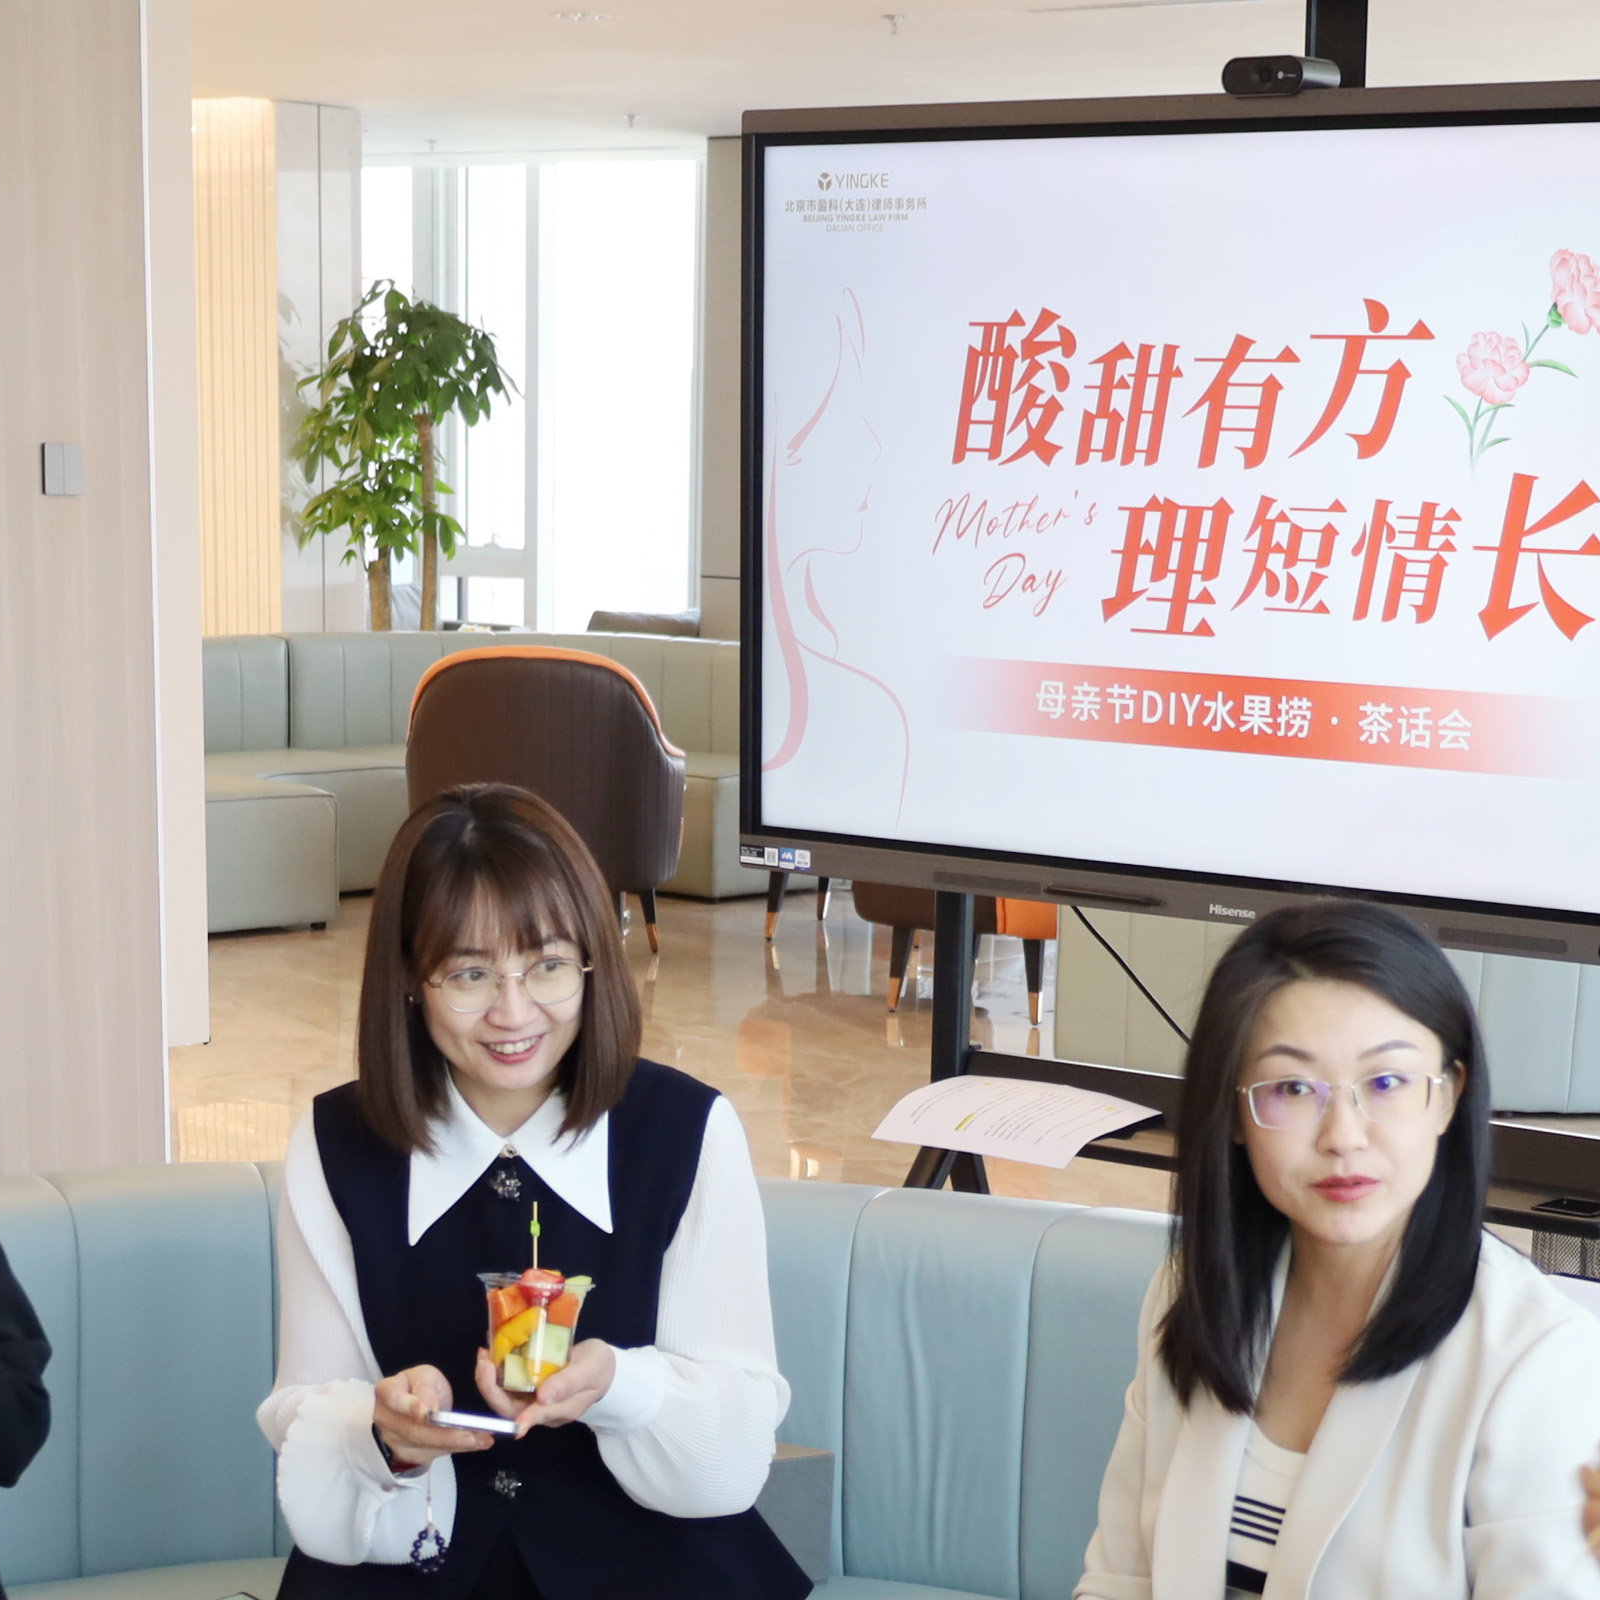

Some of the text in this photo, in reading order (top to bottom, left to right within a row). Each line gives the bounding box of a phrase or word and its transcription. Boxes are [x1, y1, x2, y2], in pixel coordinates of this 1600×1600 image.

[834, 172, 890, 189] YINGKE
[802, 213, 909, 223] BEIJING YINGKE LAW FIRM
[825, 223, 884, 233] DALIAN OFFICE
[951, 297, 1436, 470] 酸甜有方
[931, 489, 1099, 556] Mother's
[982, 552, 1068, 618] Day
[1208, 903, 1257, 919] Hisense
